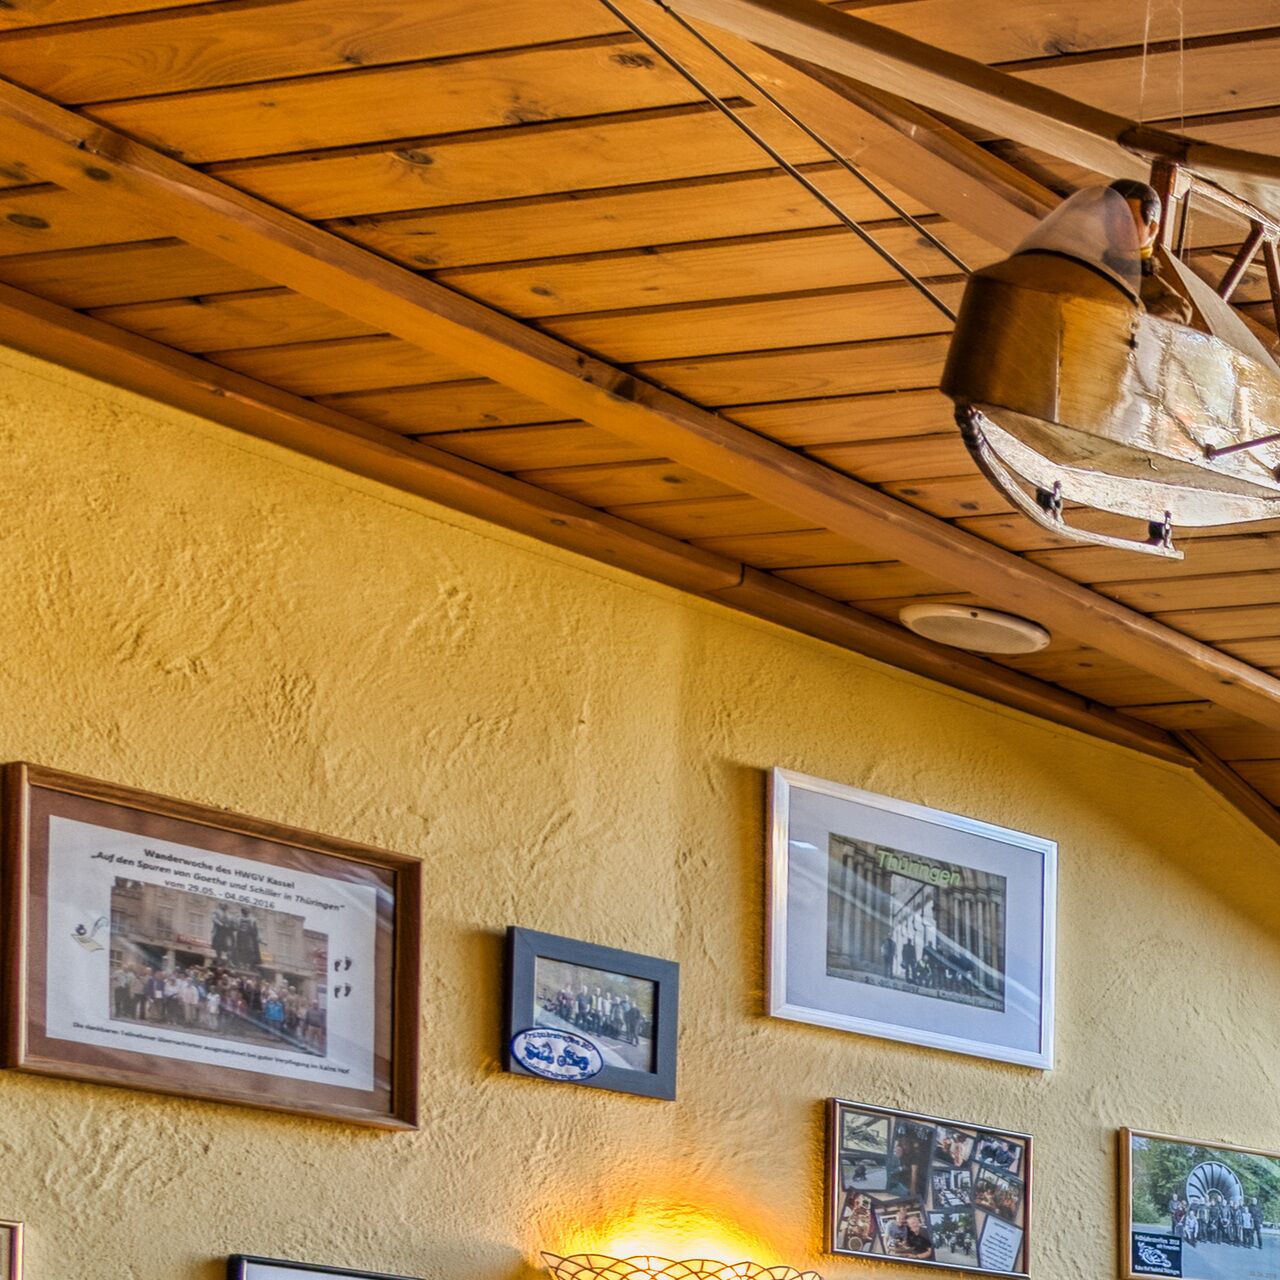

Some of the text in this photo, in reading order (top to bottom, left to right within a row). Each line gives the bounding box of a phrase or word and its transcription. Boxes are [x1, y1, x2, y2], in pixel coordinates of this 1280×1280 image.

[116, 856, 135, 866] den
[137, 860, 172, 874] Spuren
[173, 868, 191, 878] von
[193, 872, 226, 886] Goethe
[229, 881, 247, 890] und
[249, 884, 282, 898] Schiller
[283, 892, 292, 900] in
[144, 848, 296, 889] Wanderwoche des HWGV Kassel
[164, 879, 186, 889] vom
[878, 849, 961, 886] Thüringen
